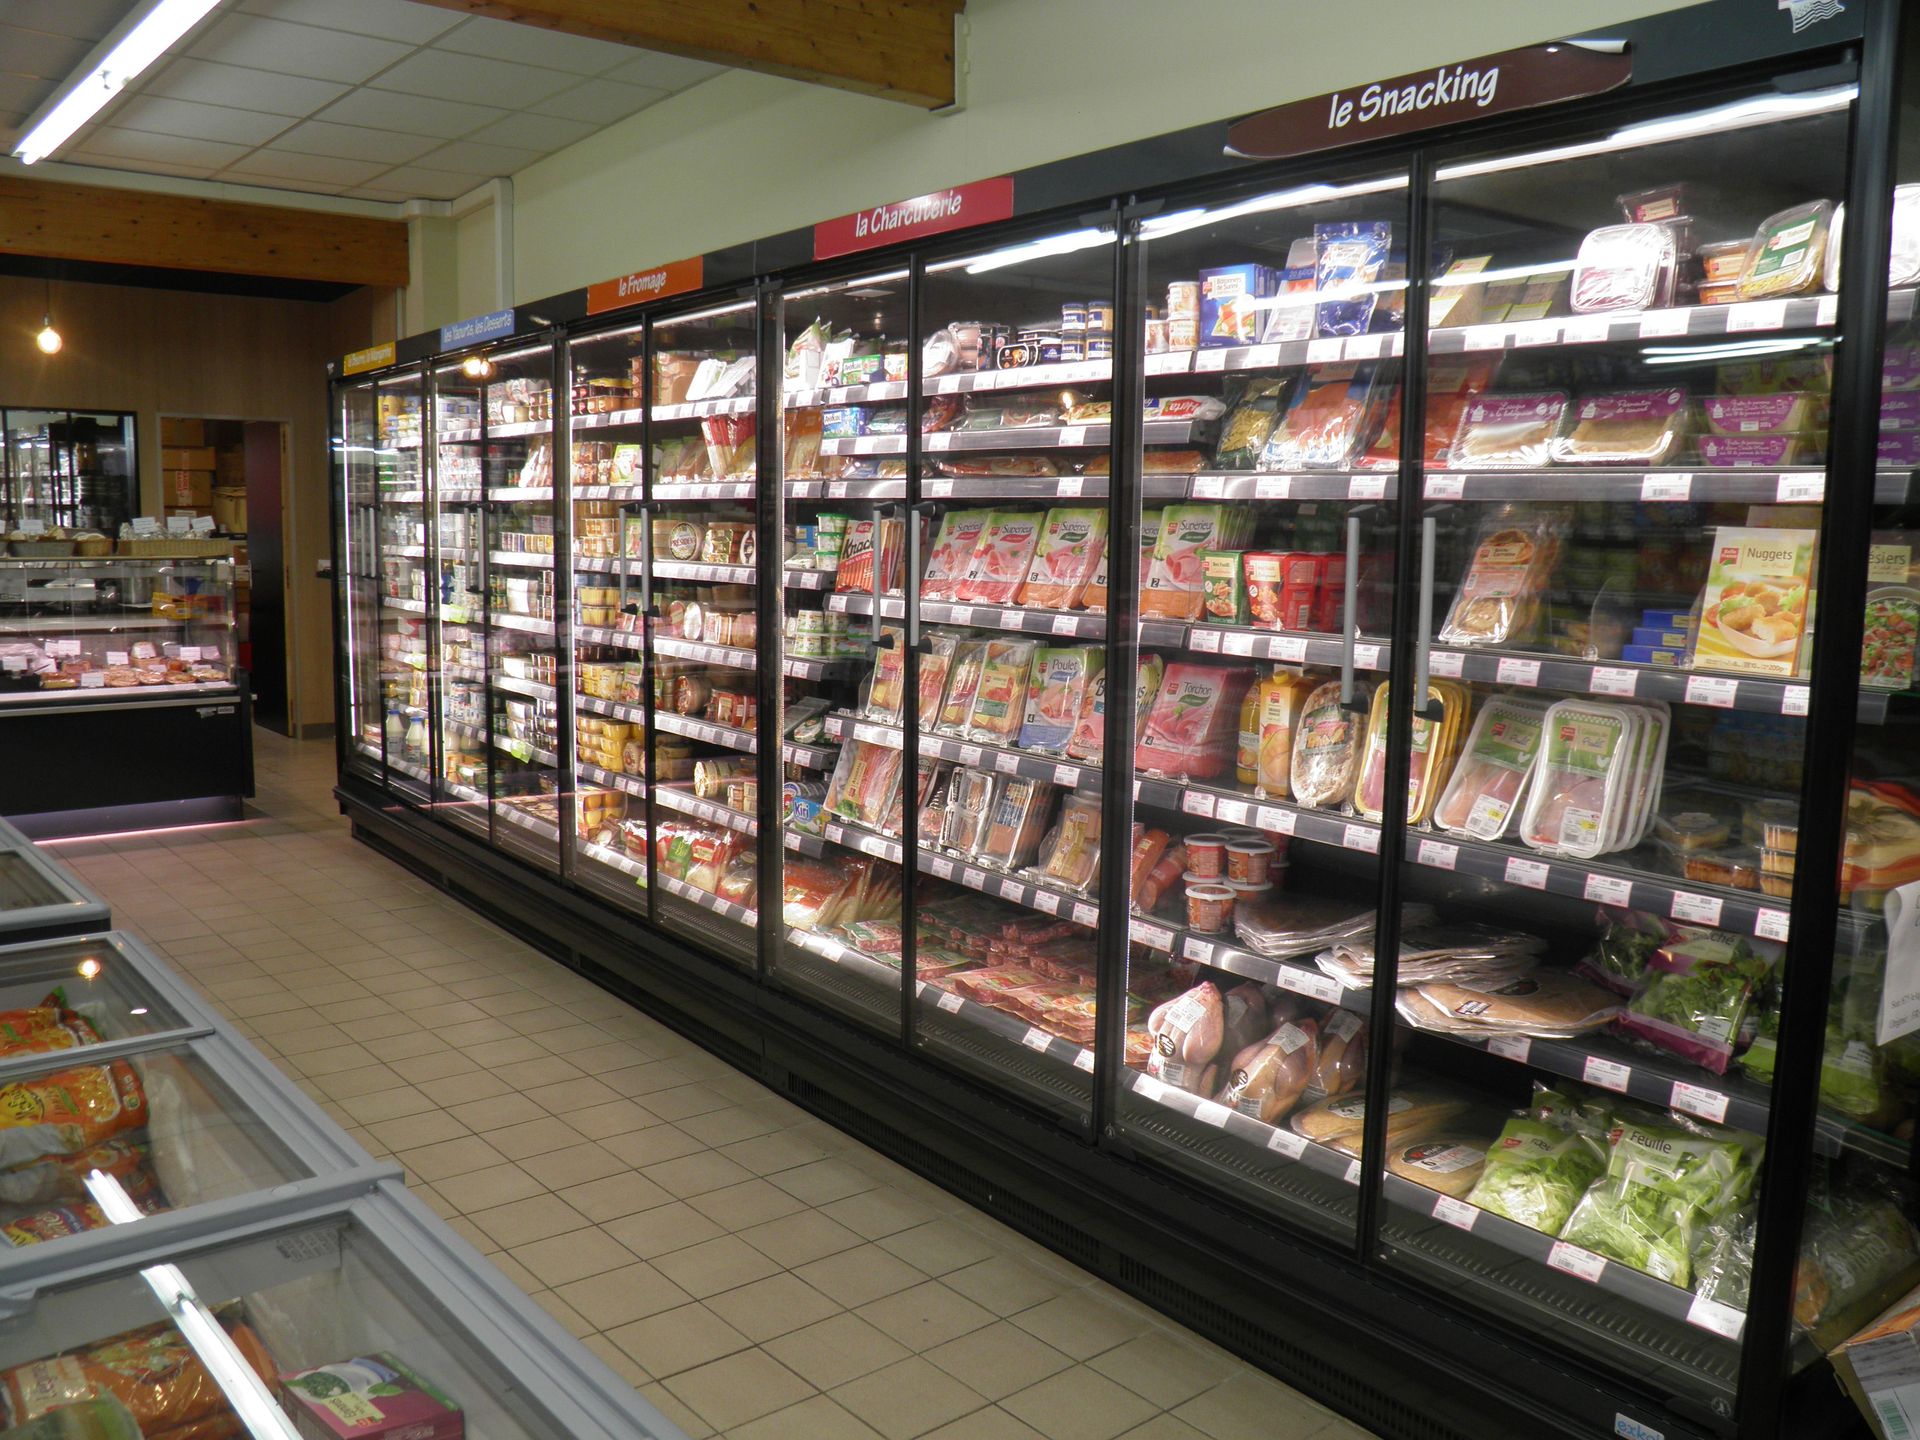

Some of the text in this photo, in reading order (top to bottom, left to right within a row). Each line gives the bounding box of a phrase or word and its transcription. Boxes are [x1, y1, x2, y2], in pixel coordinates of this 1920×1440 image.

[1328, 64, 1499, 128] le Snacking
[855, 190, 962, 238] la Charcuterie
[618, 271, 667, 297] le Fromage
[1747, 547, 1793, 562] Nuggets
[1868, 552, 1906, 566] ésiers
[1052, 659, 1078, 671] Poulet
[794, 801, 809, 819] Kiri
[1630, 1130, 1672, 1154] Feuille
